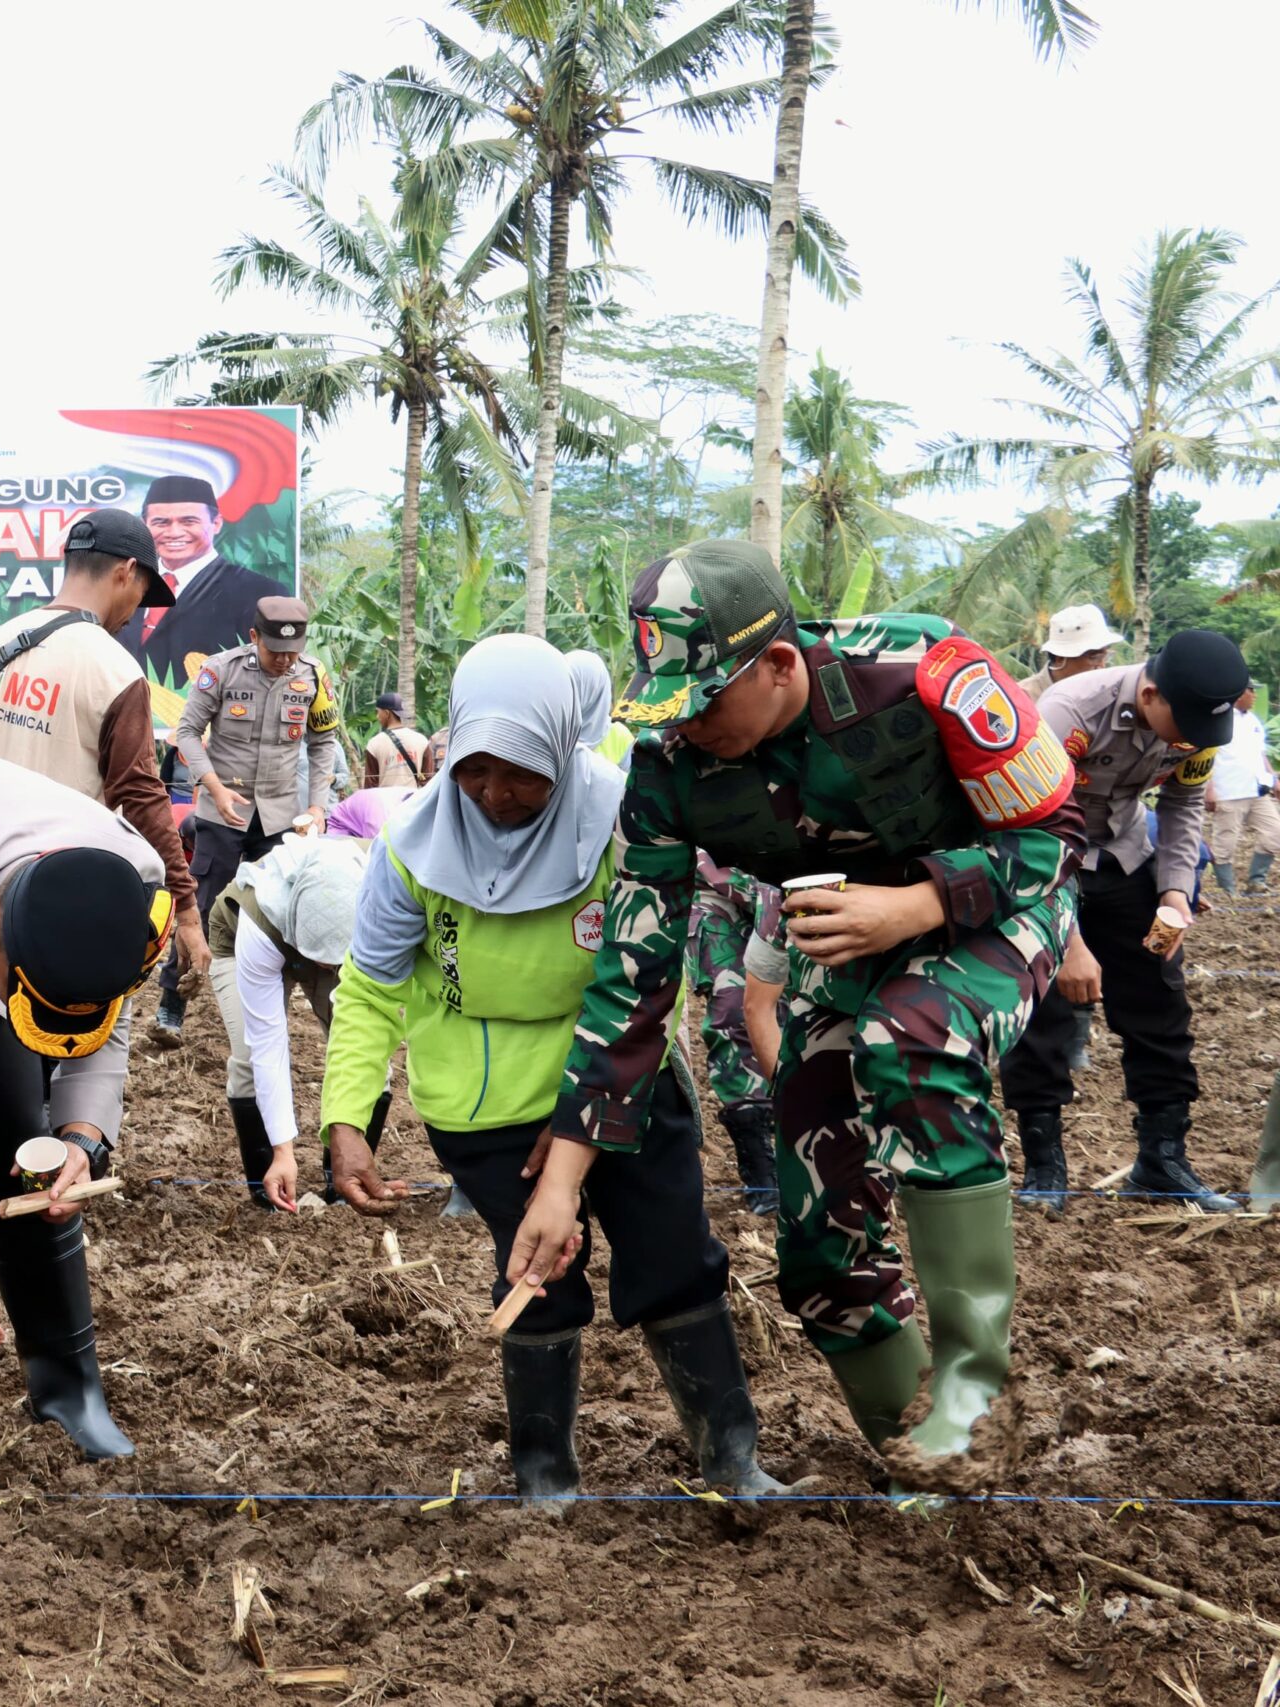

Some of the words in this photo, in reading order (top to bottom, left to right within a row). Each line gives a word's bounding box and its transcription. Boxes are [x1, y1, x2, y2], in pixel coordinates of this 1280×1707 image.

[727, 610, 778, 645] BANYUWANGI
[3, 671, 61, 716] MSI
[225, 690, 254, 701] ALDI
